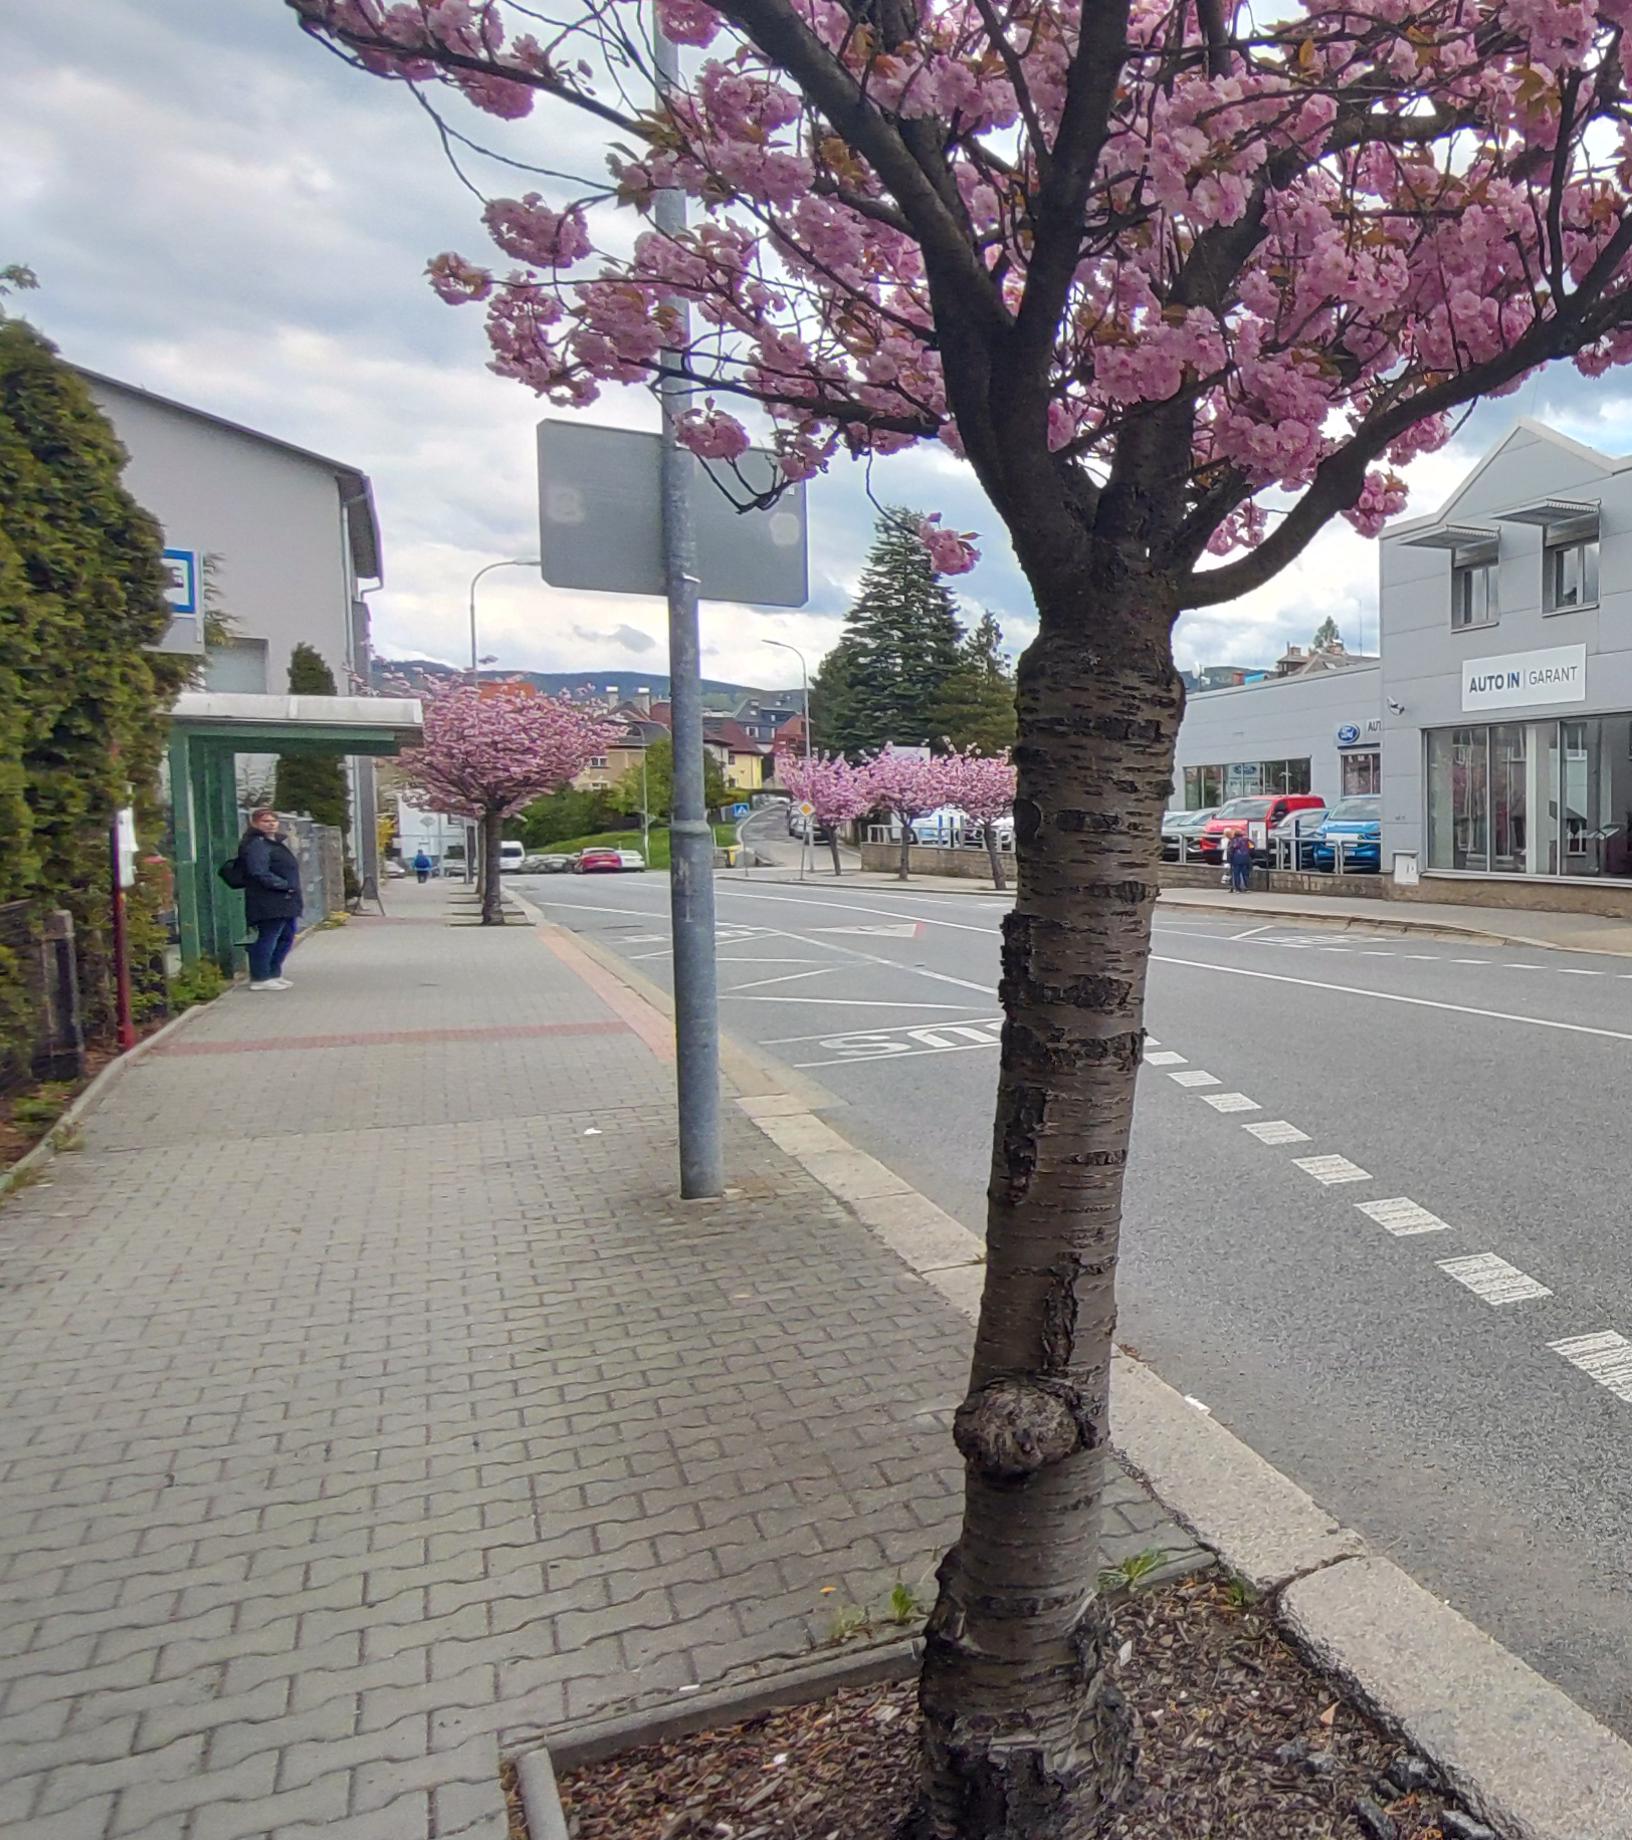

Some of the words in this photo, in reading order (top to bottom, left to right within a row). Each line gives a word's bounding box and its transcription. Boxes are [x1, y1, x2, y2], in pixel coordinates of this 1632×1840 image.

[1469, 675, 1504, 693] AUTO
[1507, 672, 1520, 689] IN
[1529, 666, 1577, 685] GARANT
[819, 1020, 1002, 1056] US
